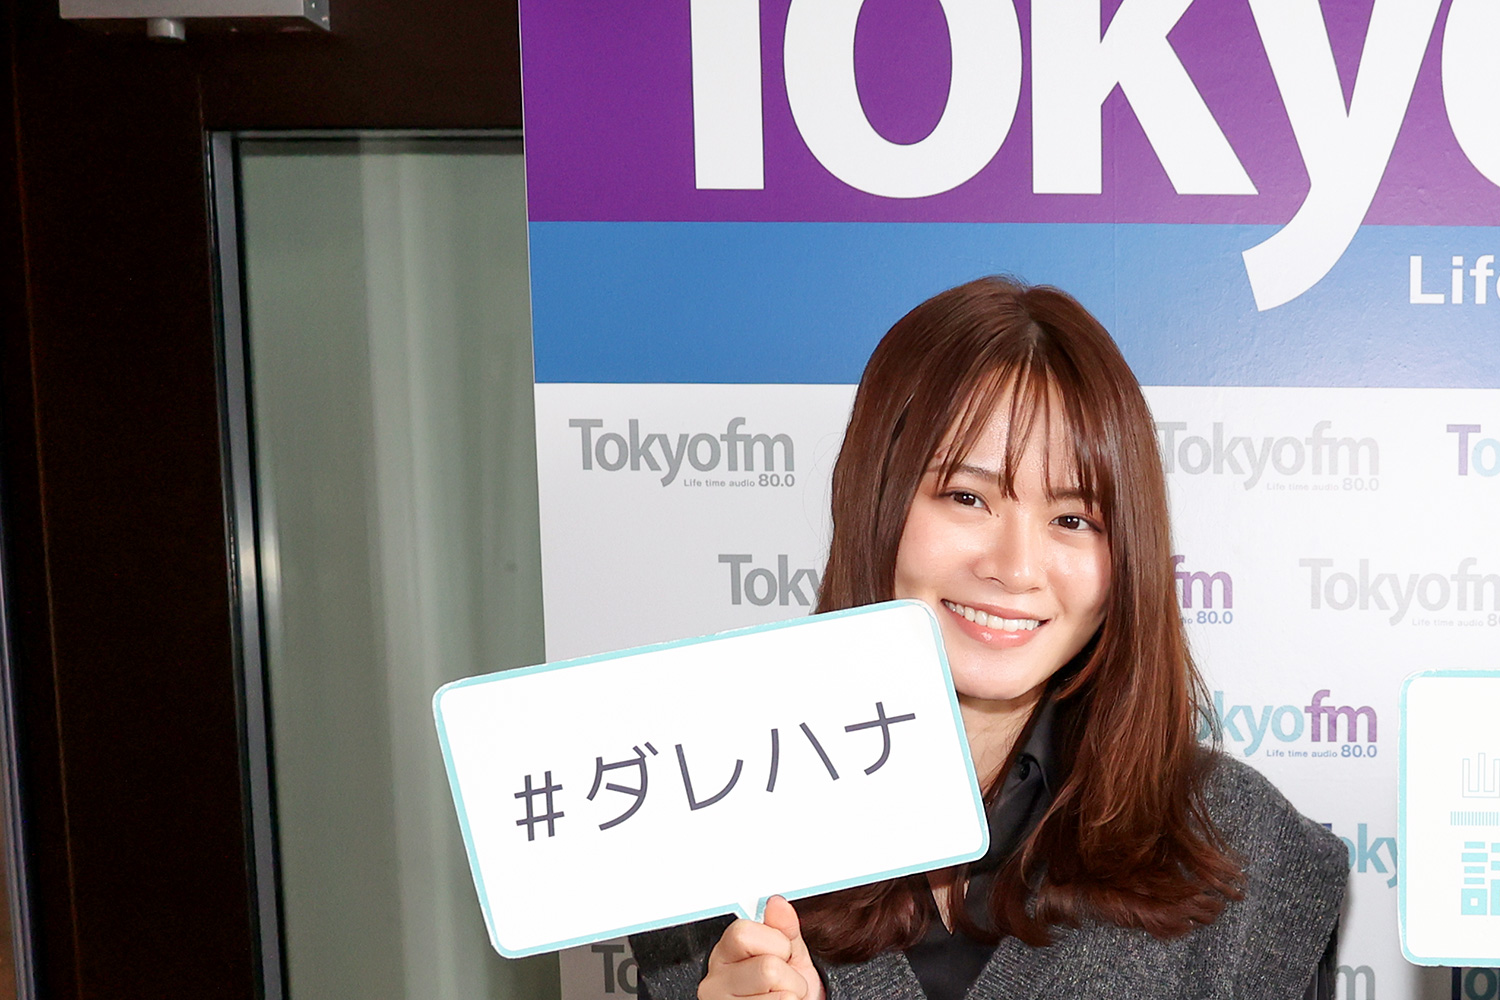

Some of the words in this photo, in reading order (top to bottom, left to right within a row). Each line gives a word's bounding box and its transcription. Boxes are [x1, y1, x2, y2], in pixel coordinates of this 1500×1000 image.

[568, 417, 795, 487] Tokyofm
[1155, 420, 1379, 490] Tokyofm
[684, 479, 702, 487] Life
[705, 479, 726, 487] time
[729, 479, 755, 487] audio
[758, 474, 795, 487] 80.0
[1342, 478, 1379, 491] 80.0
[1196, 611, 1233, 624] 80.0
[1266, 750, 1285, 758] Life
[1288, 750, 1308, 758] time
[1311, 750, 1337, 758] audio
[1340, 744, 1377, 758] 80.0
